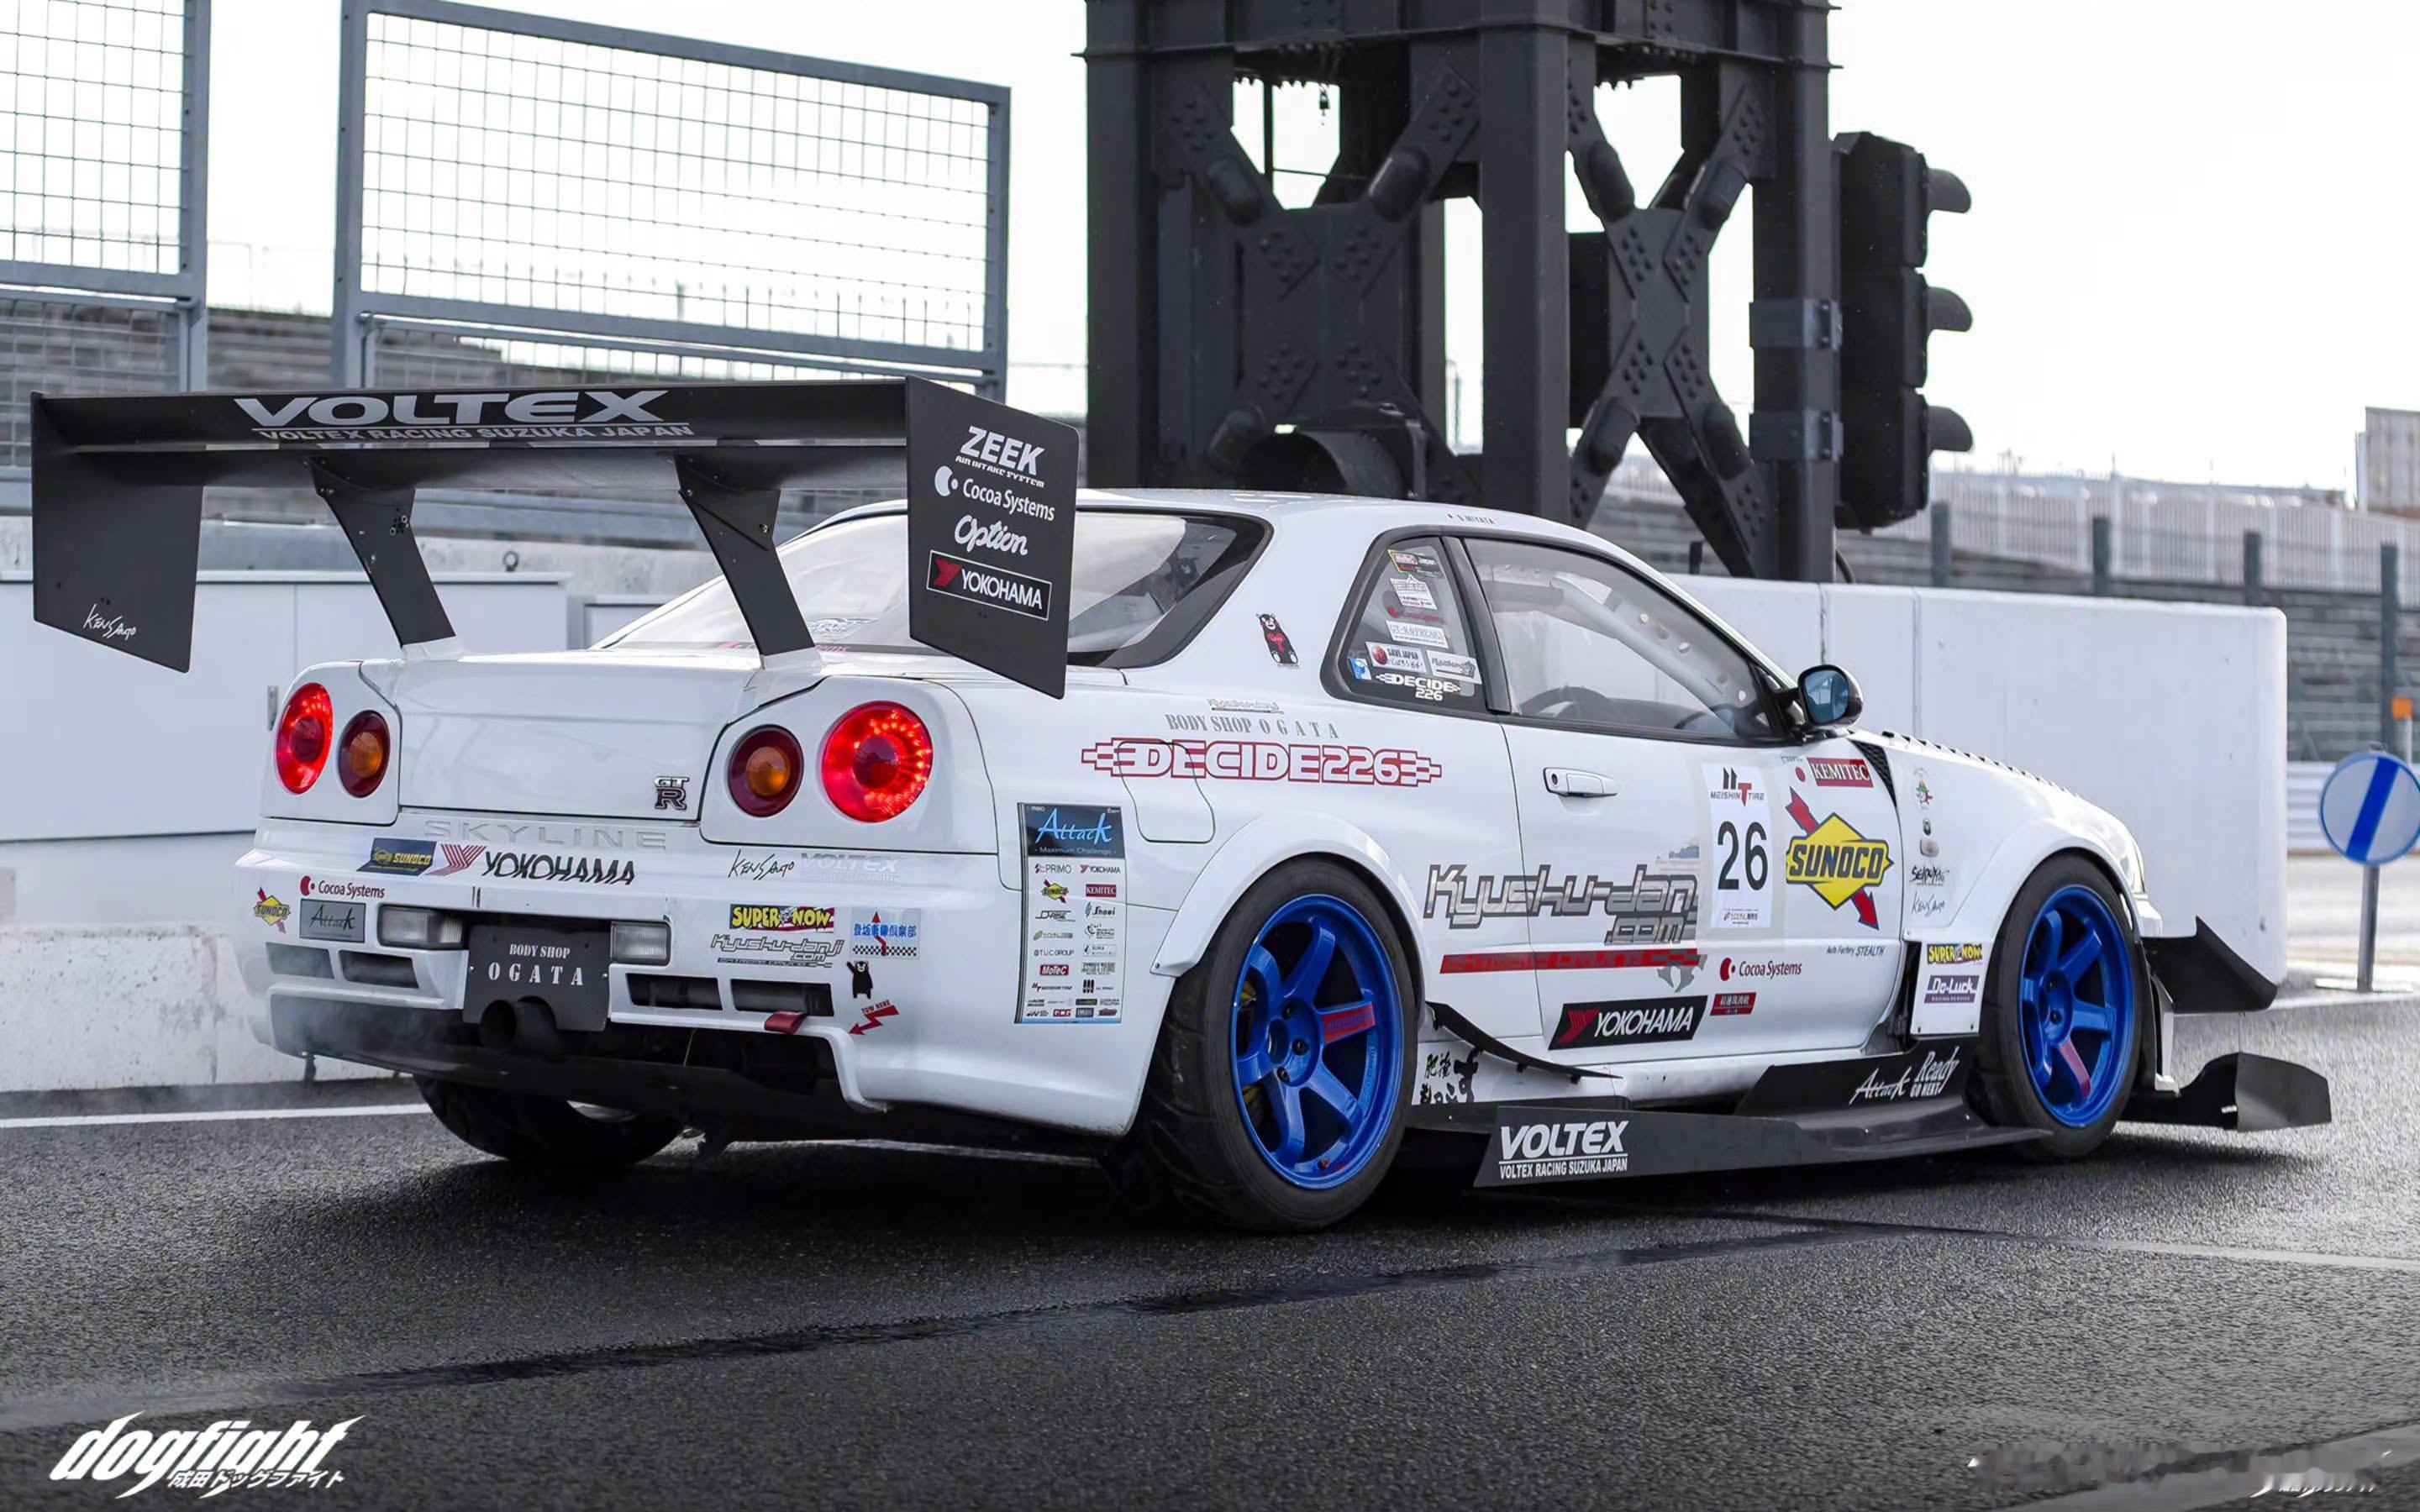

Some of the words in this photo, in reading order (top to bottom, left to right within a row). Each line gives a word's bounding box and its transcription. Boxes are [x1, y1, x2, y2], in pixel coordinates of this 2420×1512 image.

[234, 391, 670, 426] VOLTEX
[259, 428, 365, 441] VOLTEX
[371, 427, 471, 440] RACING
[481, 425, 591, 438] SUZUKA
[600, 423, 695, 437] JAPAN
[960, 425, 1044, 475] ZEEK
[955, 455, 971, 467] AIR
[972, 459, 1004, 478] INTAKE
[1007, 470, 1044, 488] SYSTEM
[963, 478, 1002, 507] Cocoa
[1004, 490, 1055, 522] Systems
[954, 514, 1028, 556] Option
[961, 567, 1043, 610] YOKOHAMA
[1386, 674, 1455, 692] DECIDE
[1415, 686, 1444, 701] 226
[1164, 713, 1208, 732] BODY
[1210, 716, 1252, 733] SHOP
[1811, 763, 1870, 781] KEMITEC
[1710, 792, 1740, 801] MEISHIN
[424, 820, 666, 851] SKYLINE
[1034, 807, 1113, 845] Attack
[392, 853, 433, 865] SUNOCO
[1717, 821, 1768, 890] 26
[1789, 844, 1885, 879] SUNOCO
[481, 850, 634, 885] YOKOHAMA
[1045, 864, 1071, 874] PRIMO
[318, 880, 345, 896] Cocoa
[346, 883, 385, 899] Systems
[256, 904, 287, 917] SUNOCO
[732, 906, 780, 927] SUPER
[509, 943, 539, 958] BODY
[540, 945, 571, 959] SHOP
[1855, 945, 1885, 957] STEALTH
[1928, 945, 1955, 962] SUPER
[1739, 961, 1765, 977] Cocoa
[1766, 960, 1802, 979] Systems
[1594, 1006, 1694, 1037] YOKOHAMA
[1849, 1066, 1912, 1105] Attack
[1914, 1046, 1960, 1094] Ready
[1501, 1121, 1628, 1160] VOLTEX
[1500, 1164, 1534, 1179] VOLTEX
[1535, 1161, 1567, 1177] RACING
[1569, 1158, 1601, 1174] SUZUKA
[1602, 1158, 1628, 1173] JAPAN
